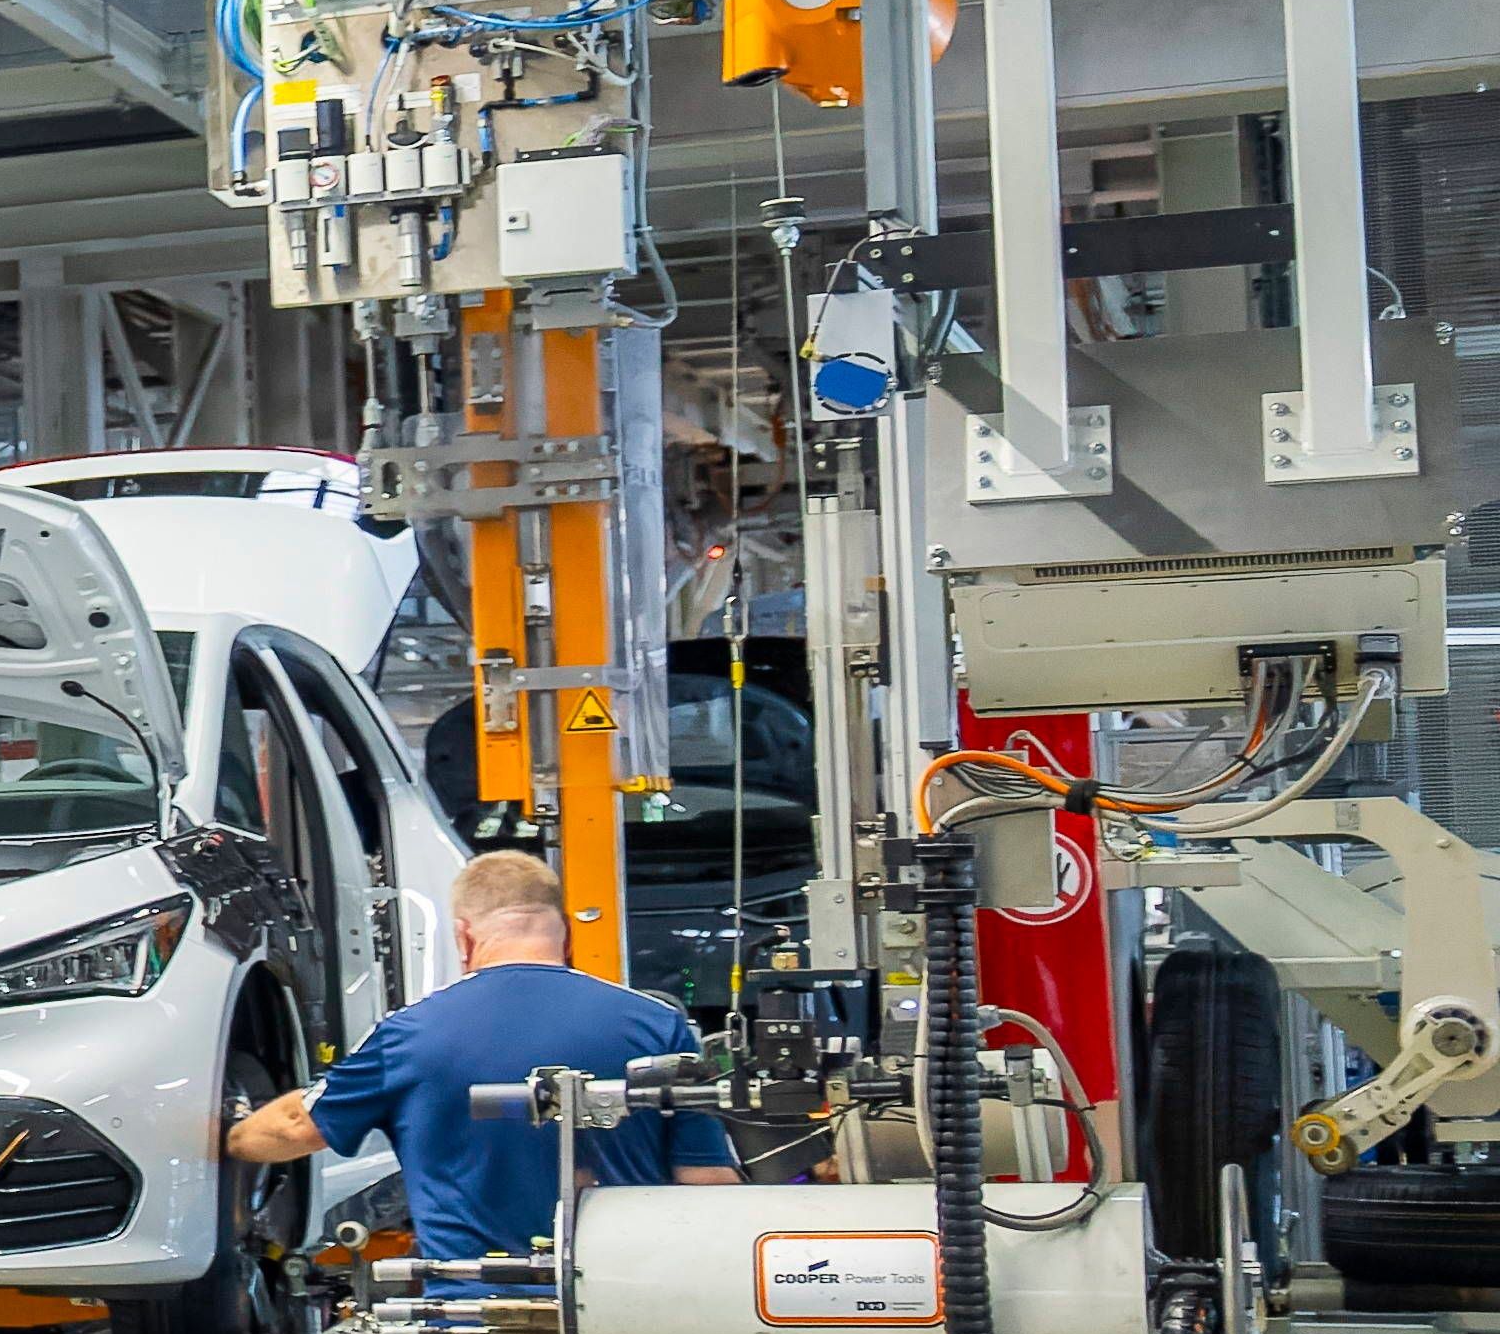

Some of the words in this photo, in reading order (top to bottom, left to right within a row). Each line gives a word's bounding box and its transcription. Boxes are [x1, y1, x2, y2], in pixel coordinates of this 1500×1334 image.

[774, 1273, 840, 1285] COOPER
[844, 1273, 887, 1285] Power
[892, 1273, 926, 1285] Tools
